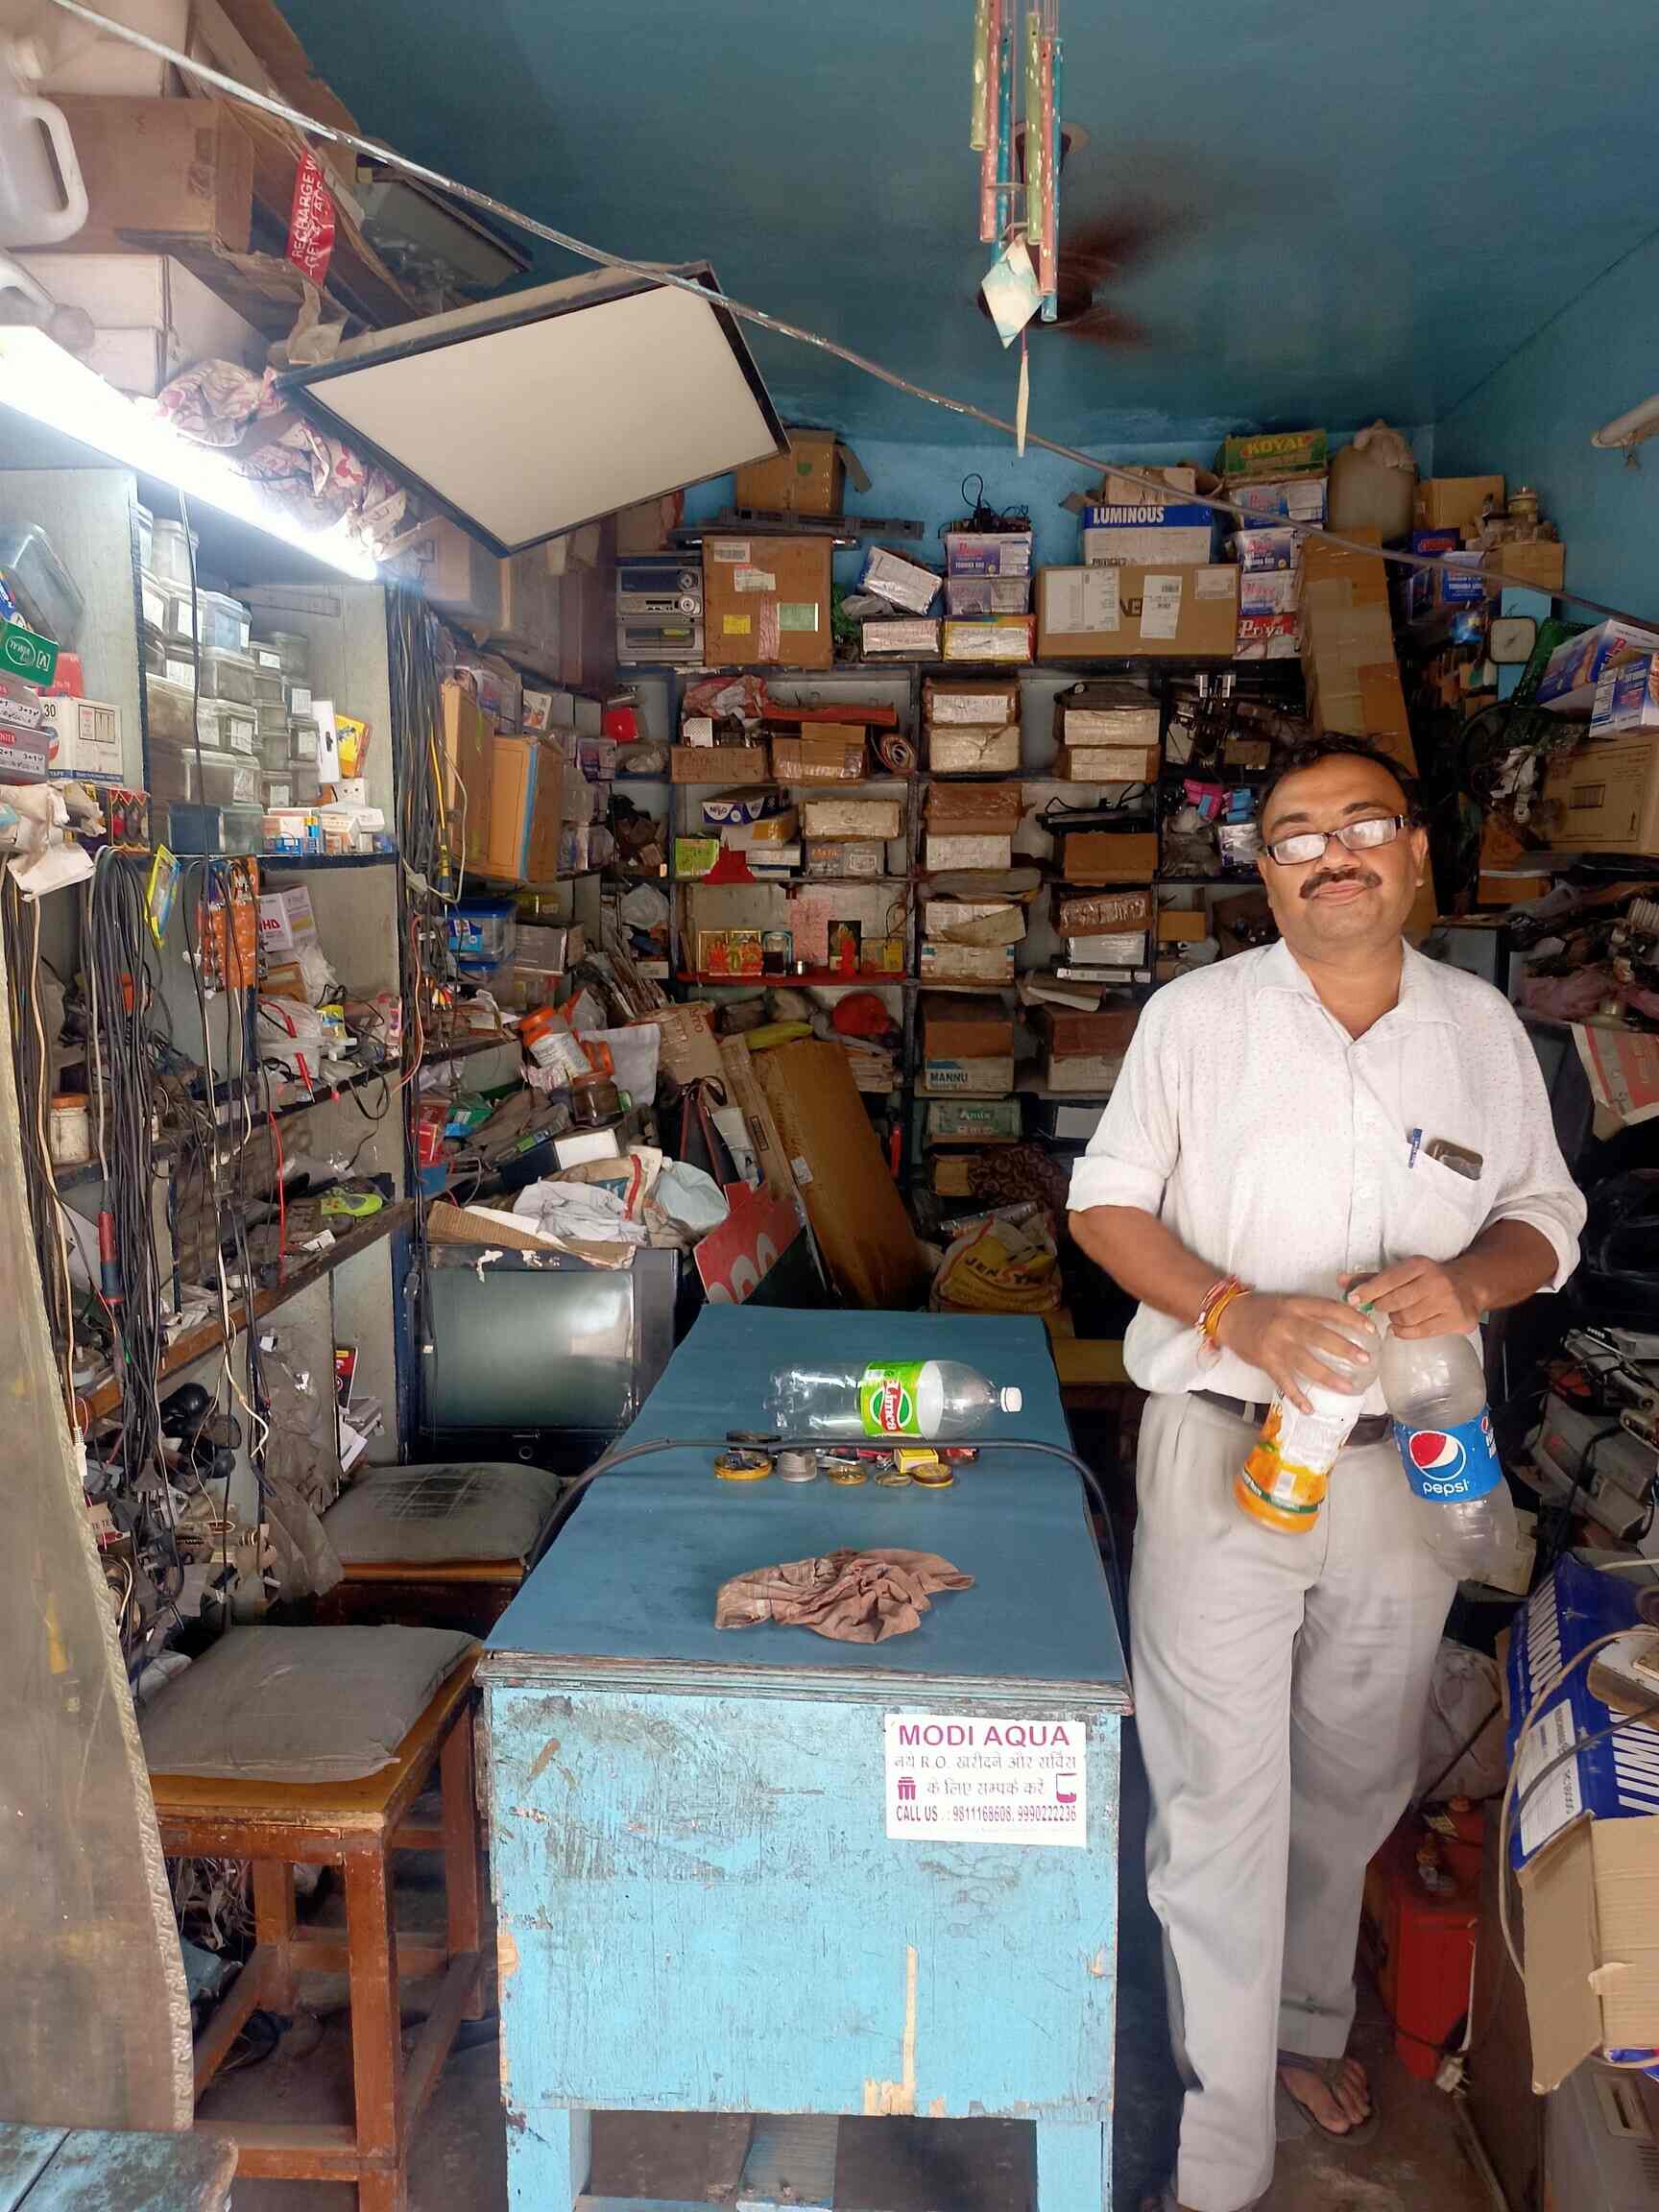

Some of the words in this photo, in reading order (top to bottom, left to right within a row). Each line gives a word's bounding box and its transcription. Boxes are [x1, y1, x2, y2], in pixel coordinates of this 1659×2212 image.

[292, 173, 315, 259] RECHARGE
[1094, 506, 1165, 524] LUMINOUS
[43, 704, 57, 717] 30
[884, 1379, 900, 1431] Limca
[1423, 1479, 1469, 1497] pepsi
[899, 1724, 974, 1746] MODI
[983, 1725, 1070, 1747] AQUA
[897, 1805, 922, 1821] CALL
[925, 1805, 938, 1821] US
